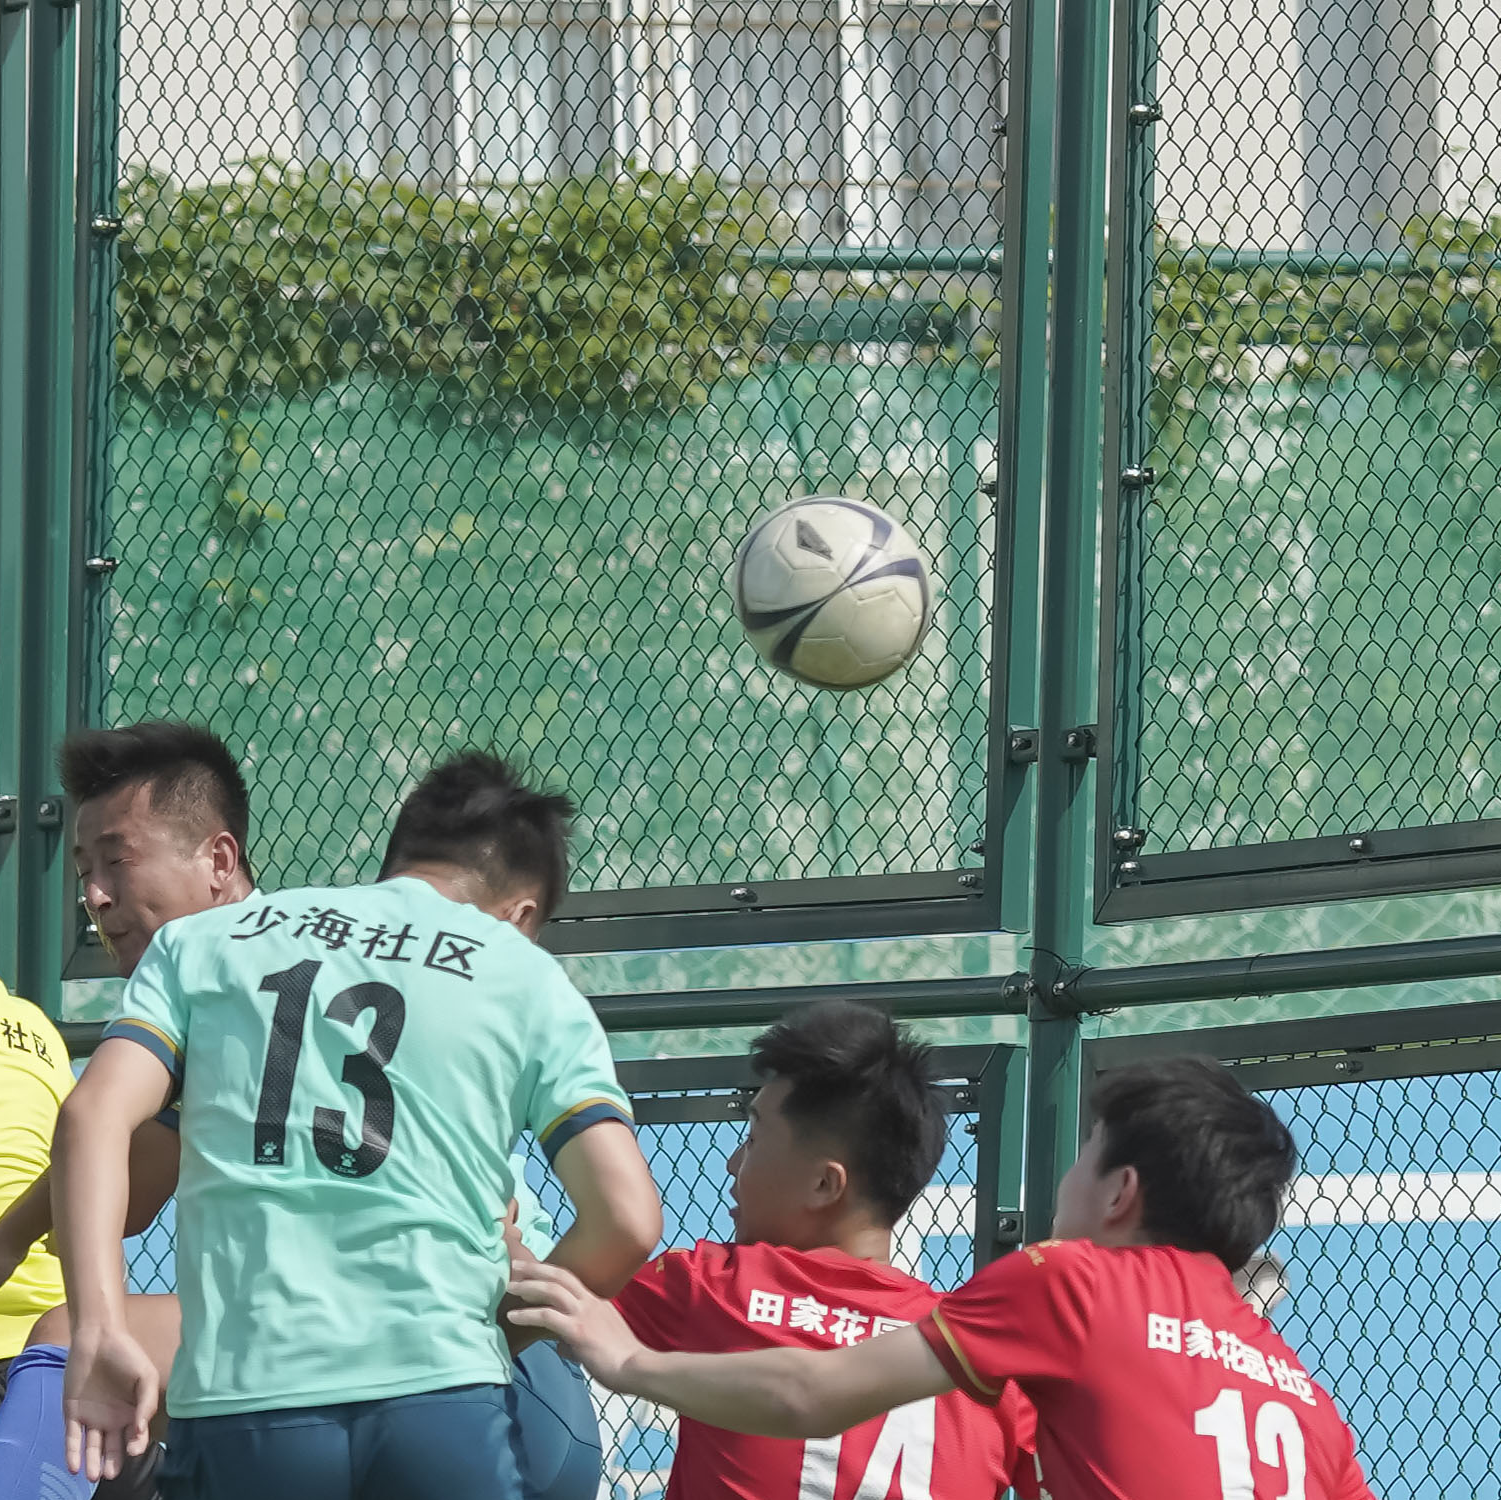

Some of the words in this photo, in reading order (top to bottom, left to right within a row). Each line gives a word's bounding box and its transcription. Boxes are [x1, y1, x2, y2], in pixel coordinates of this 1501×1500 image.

[229, 905, 485, 982] 少海社区
[254, 958, 406, 1179] 13
[1147, 1312, 1317, 1407] 田家花园社区
